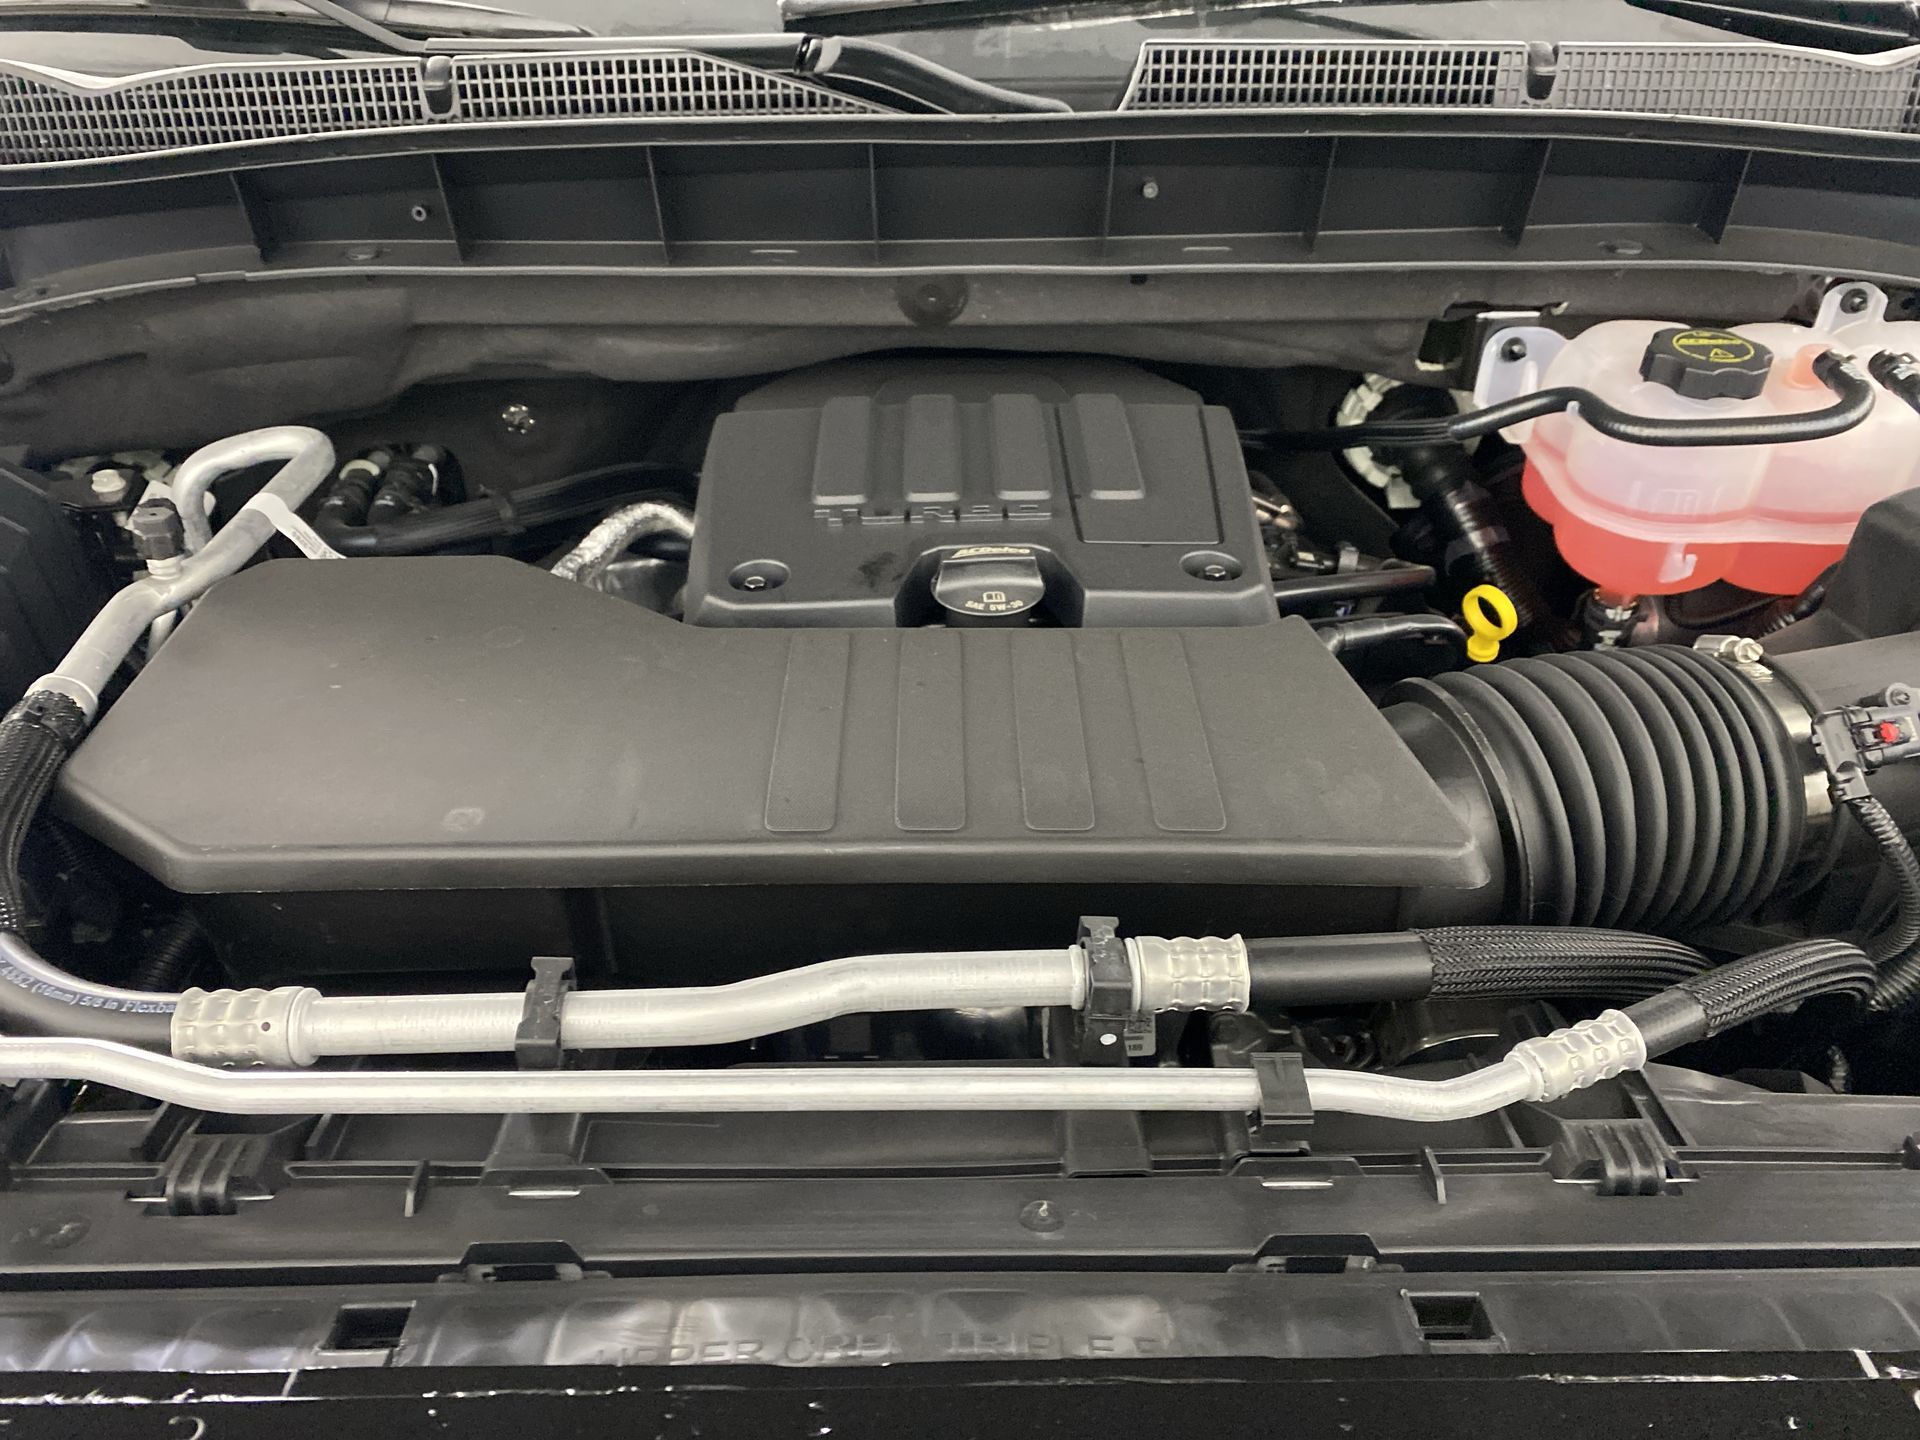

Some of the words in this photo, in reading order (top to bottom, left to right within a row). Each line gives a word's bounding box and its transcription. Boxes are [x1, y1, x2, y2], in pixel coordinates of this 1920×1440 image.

[965, 600, 985, 611] SAE
[989, 600, 1024, 612] 5W-30
[31, 982, 81, 1005] (16mm)
[80, 996, 103, 1008] 5/8
[103, 998, 117, 1010] in
